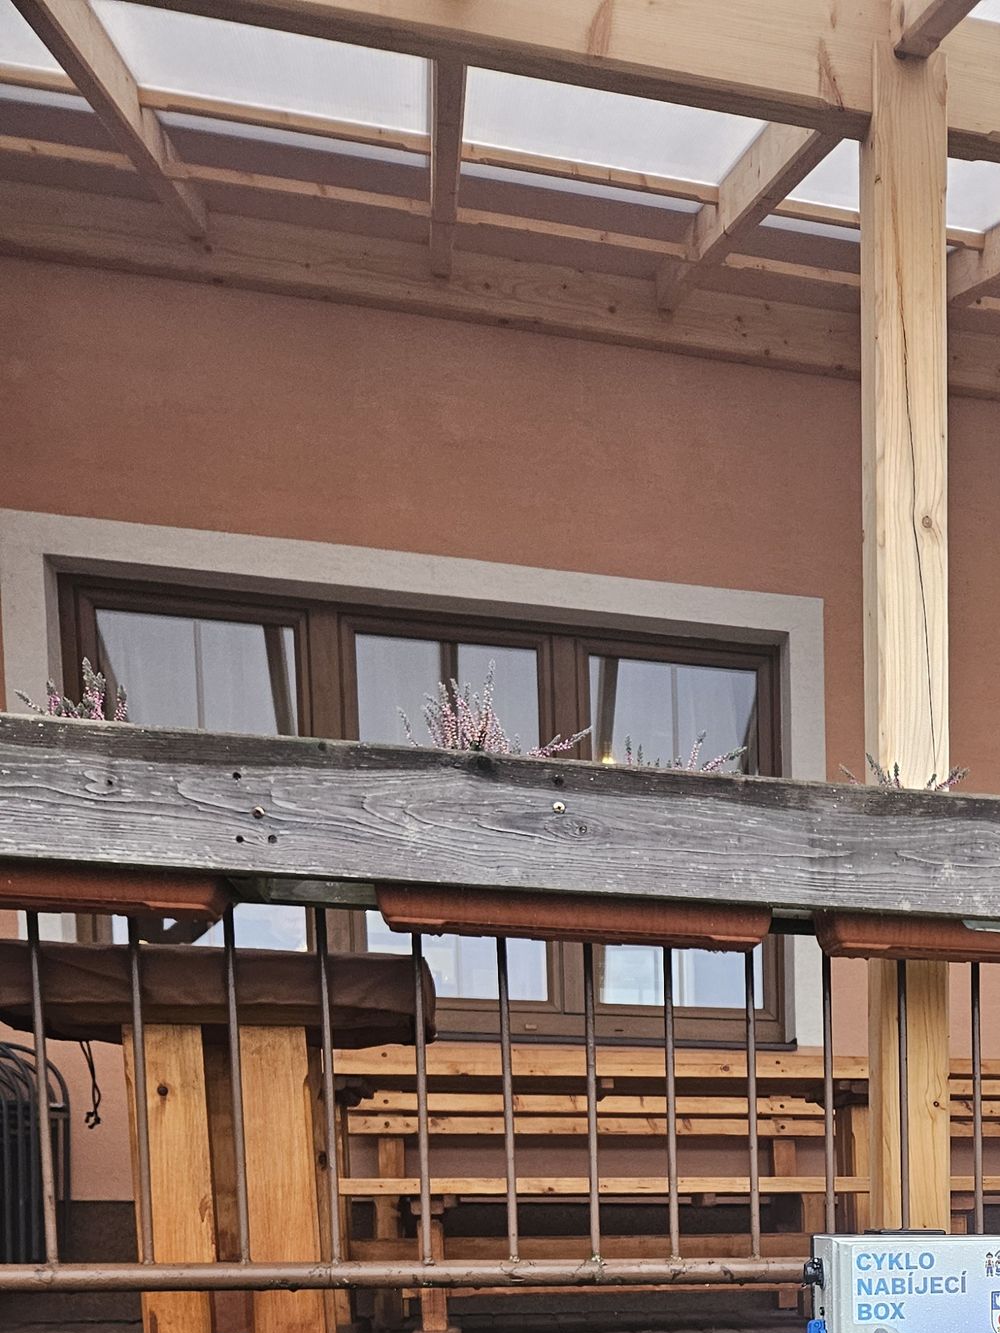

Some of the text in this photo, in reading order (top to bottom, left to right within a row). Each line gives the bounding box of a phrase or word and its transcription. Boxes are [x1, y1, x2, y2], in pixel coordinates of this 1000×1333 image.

[856, 1252, 935, 1271] CYKLO
[857, 1270, 967, 1296] NABÍJECÍ
[857, 1302, 905, 1320] BOX
